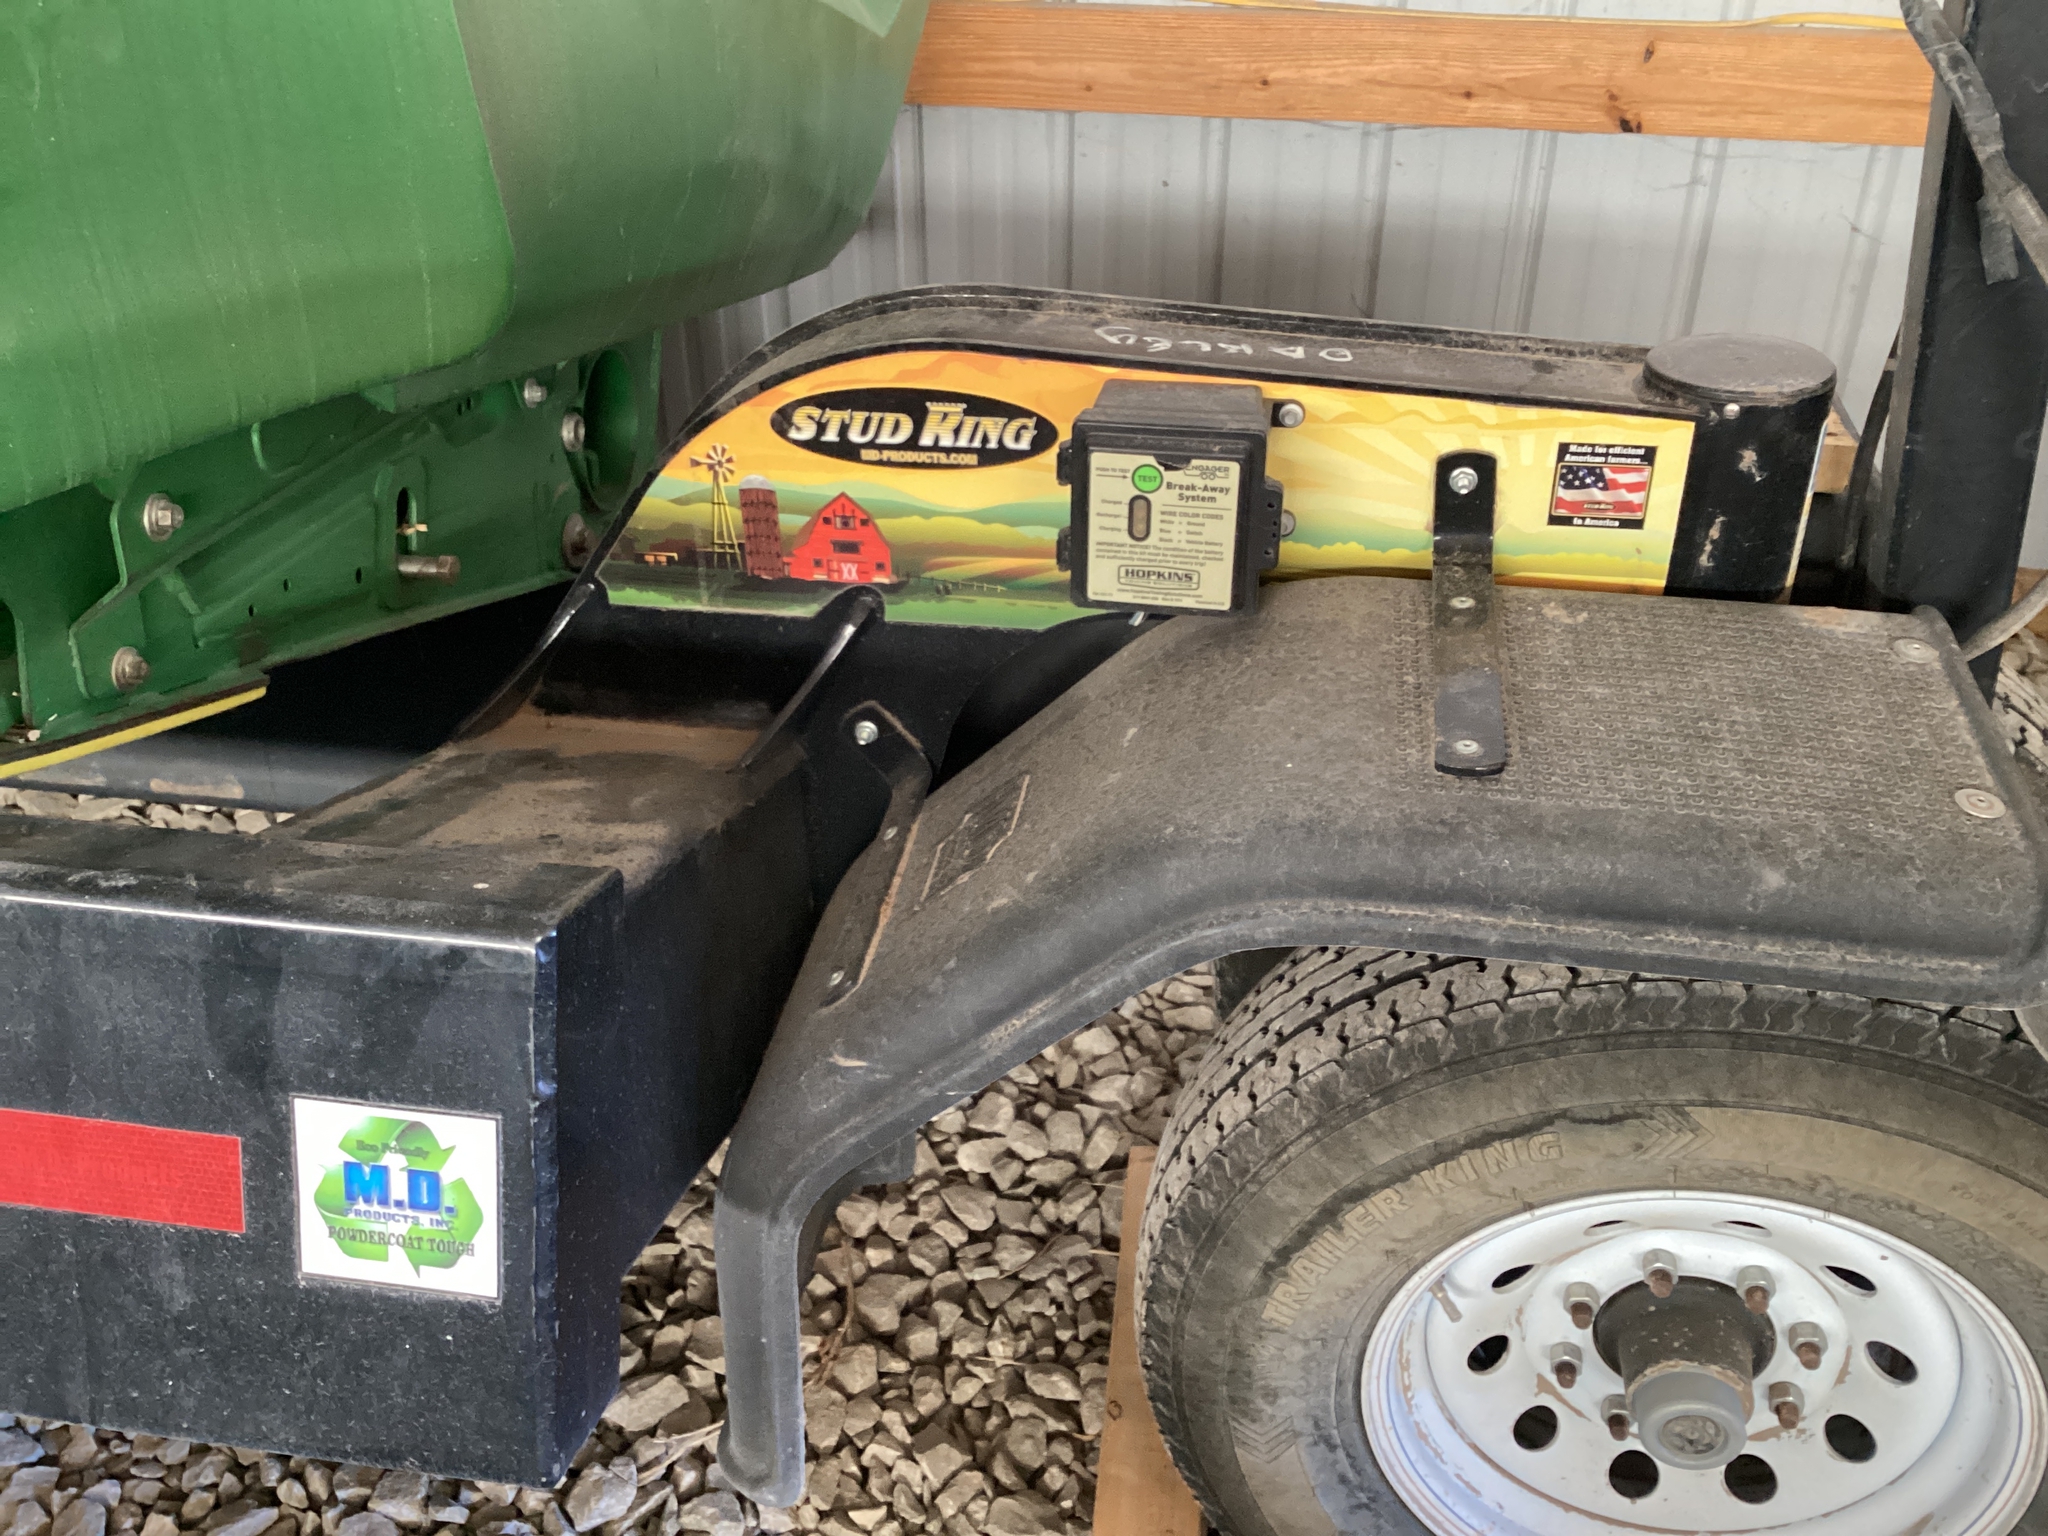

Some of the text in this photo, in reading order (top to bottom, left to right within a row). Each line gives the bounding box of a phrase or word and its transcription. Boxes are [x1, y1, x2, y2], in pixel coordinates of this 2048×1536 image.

[787, 403, 1038, 450] STUD KING
[1568, 444, 1645, 455] Made for efficient
[1564, 453, 1606, 463] American
[1138, 474, 1158, 483] TEST
[1166, 481, 1231, 495] Break-Away
[1178, 492, 1217, 504] System
[1178, 511, 1201, 519] COLOR
[1583, 518, 1620, 527] America
[1125, 568, 1194, 582] HOPKINS
[343, 1160, 457, 1217] M.D.
[343, 1207, 425, 1228] PRODUCTS,
[1261, 1130, 1565, 1328] TRAILER KING
[328, 1225, 476, 1257] POWDERCOAT TOUGH
